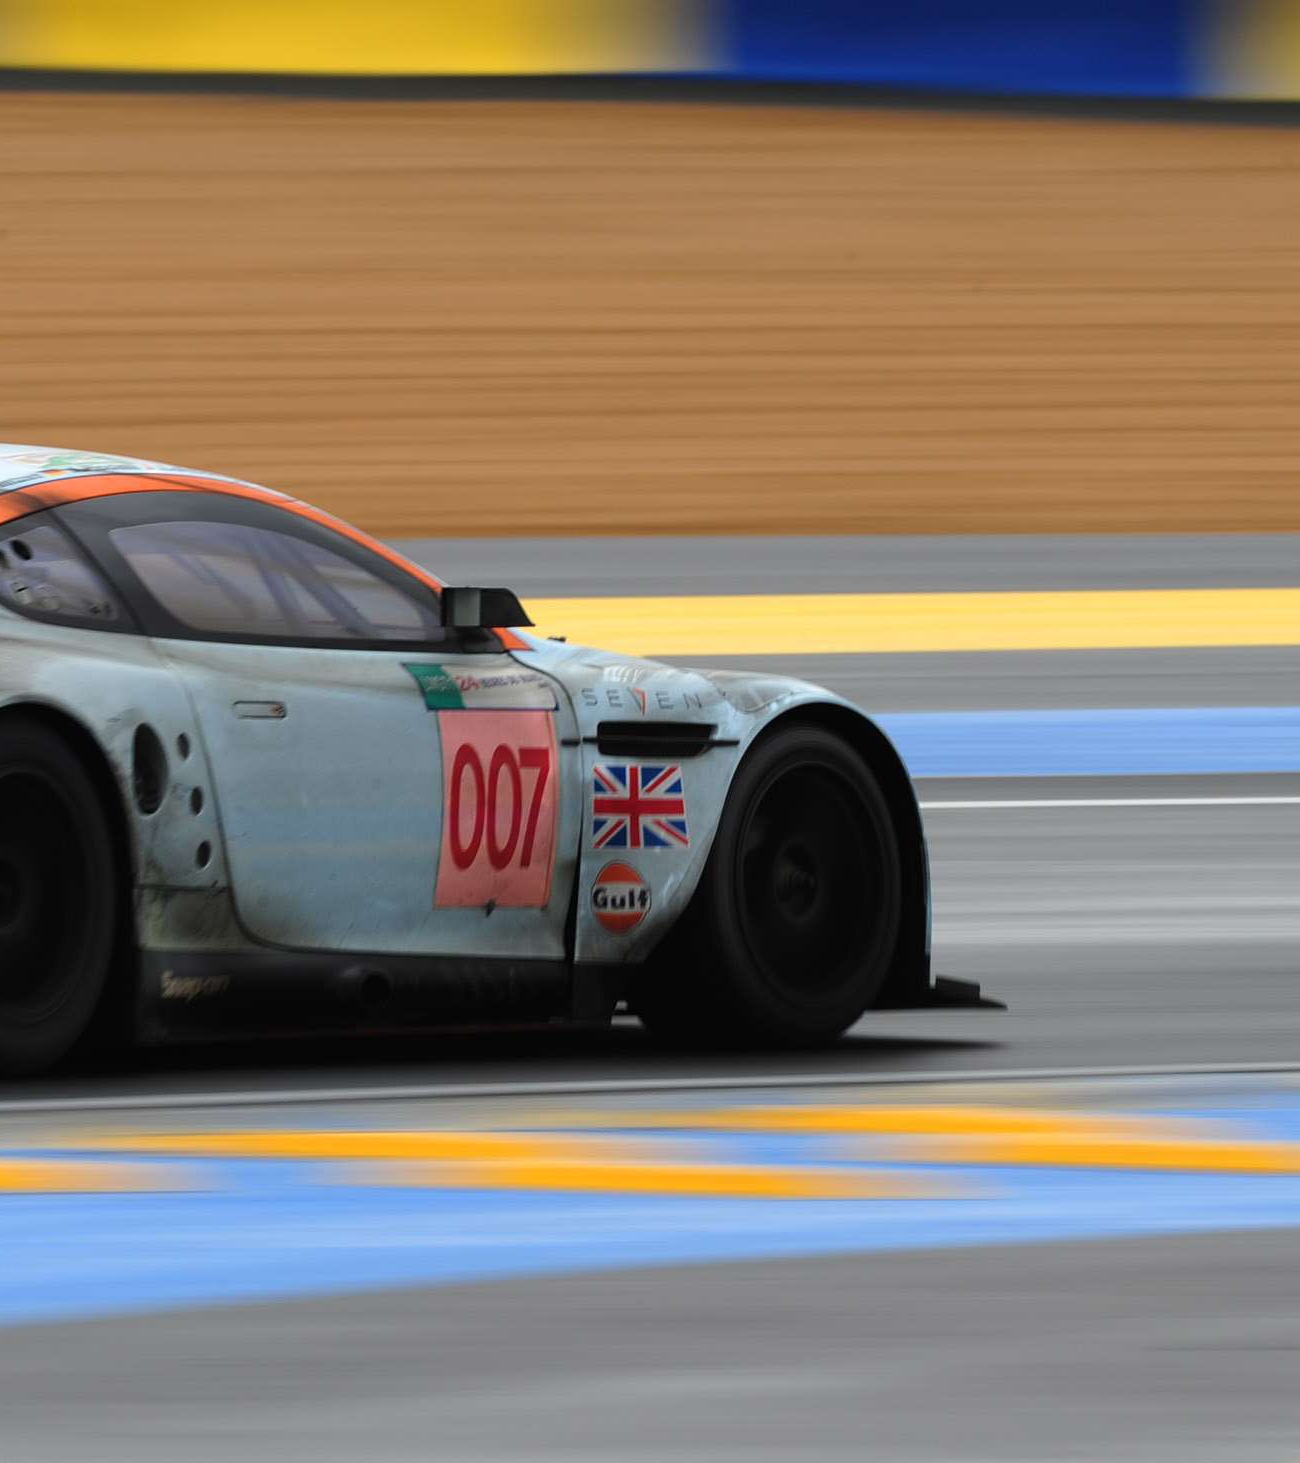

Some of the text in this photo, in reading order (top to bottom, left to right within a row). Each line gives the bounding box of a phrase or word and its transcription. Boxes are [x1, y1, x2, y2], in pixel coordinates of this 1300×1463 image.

[580, 686, 703, 718] SEVEN
[449, 742, 551, 870] 007
[592, 887, 651, 910] Gulf
